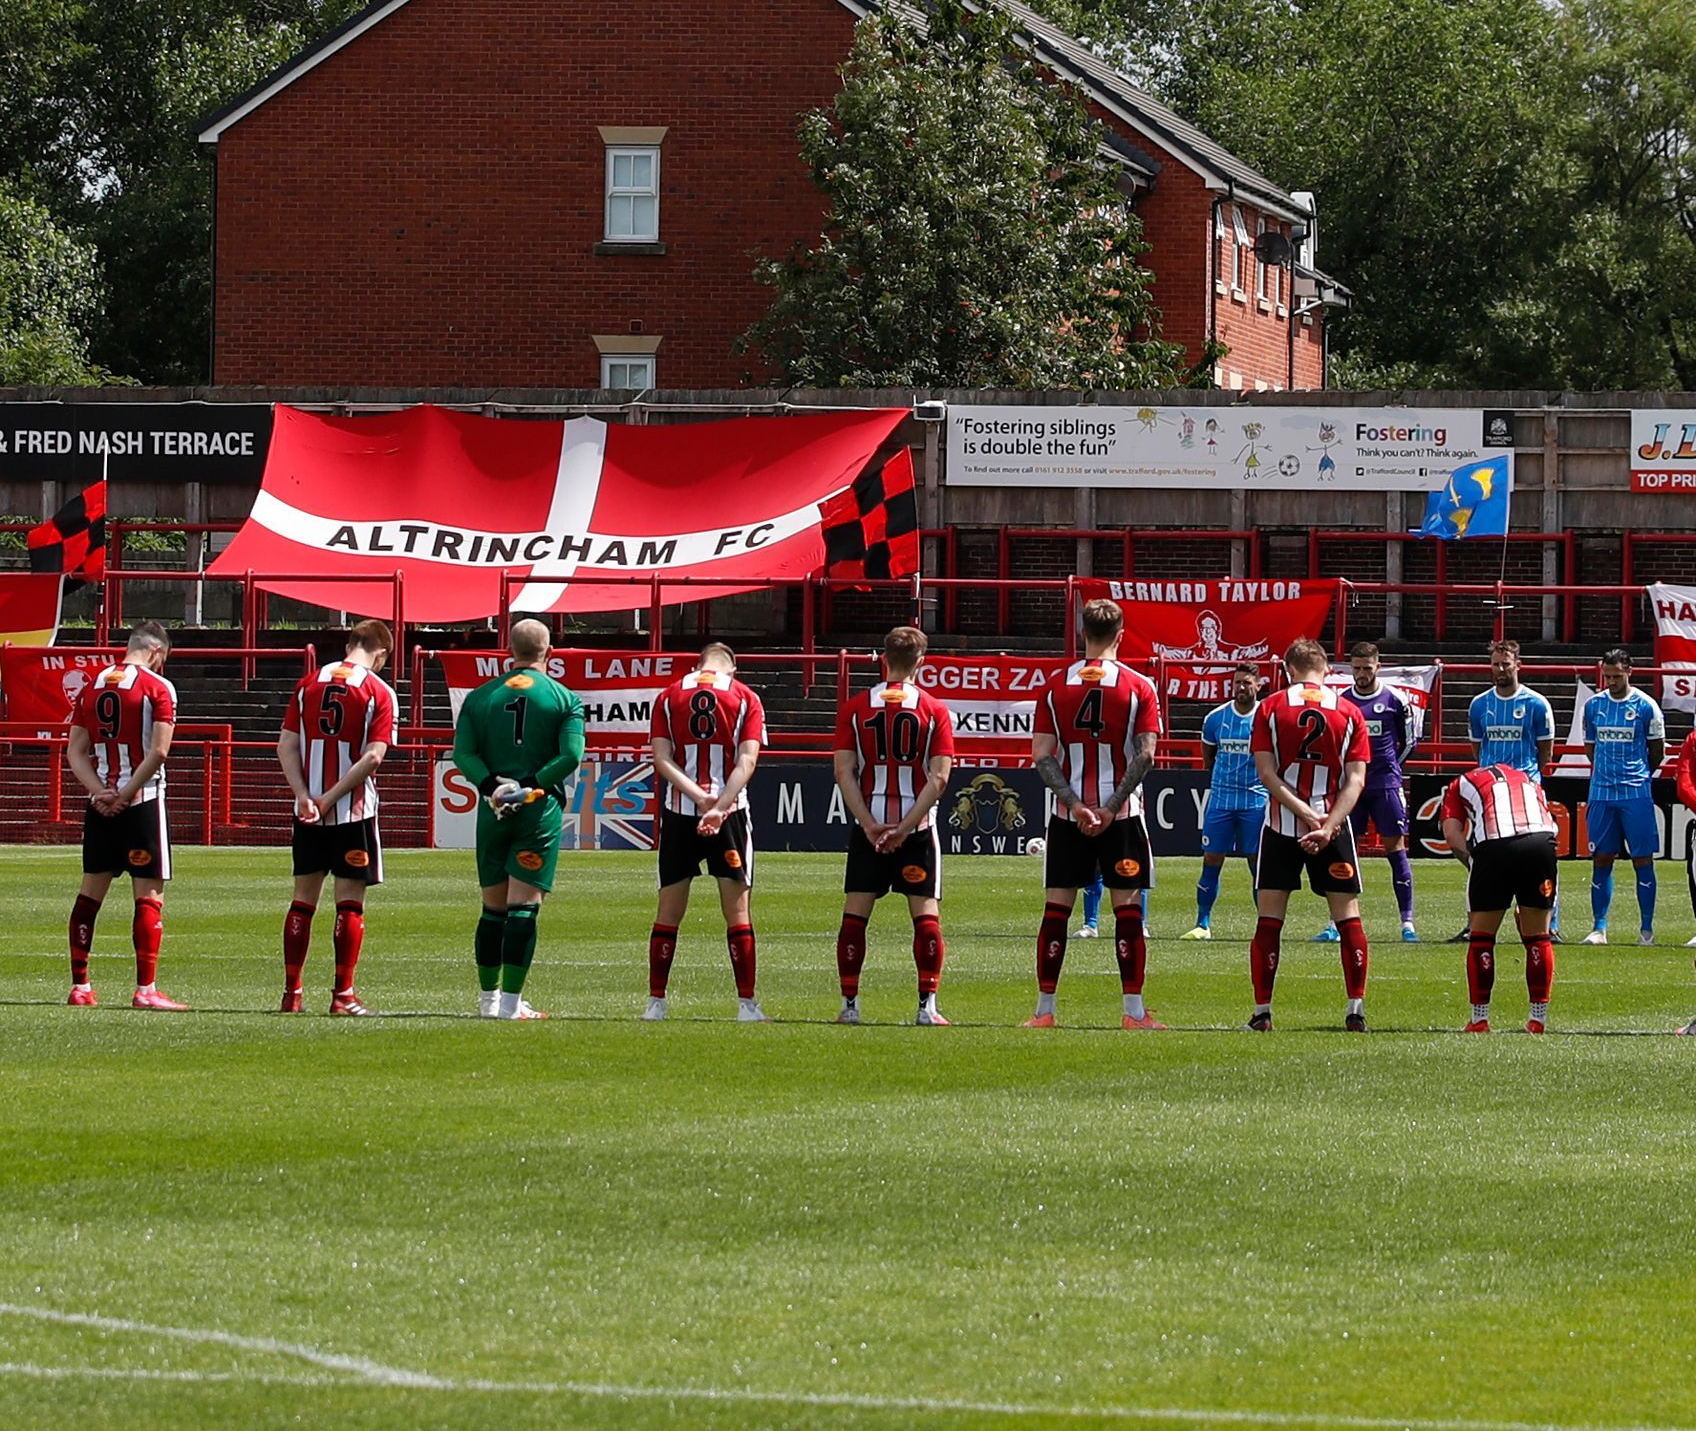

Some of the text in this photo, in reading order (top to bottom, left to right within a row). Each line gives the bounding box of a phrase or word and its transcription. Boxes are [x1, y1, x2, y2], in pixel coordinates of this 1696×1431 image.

[1050, 419, 1116, 438] siblings
[1356, 423, 1447, 446] Fostering
[14, 430, 72, 454] FRED
[79, 431, 143, 455] NASH
[150, 431, 254, 456] TERRACE
[963, 438, 977, 455] is
[981, 439, 1042, 455] double
[1047, 439, 1075, 455] the
[1357, 448, 1381, 457] Think
[1381, 450, 1399, 459] you
[1427, 449, 1450, 458] Think
[1452, 449, 1478, 460] again.
[964, 465, 972, 473] To
[1021, 465, 1034, 474] call
[1638, 474, 1665, 489] TOP
[327, 523, 775, 565] ALTRINCHAM FC
[1109, 581, 1301, 603] BERNARD TAYLOR
[42, 656, 65, 670] IN
[475, 656, 674, 679] MS LANE
[917, 664, 1001, 690] GGER
[1186, 679, 1218, 699] THE
[95, 690, 122, 739] 9
[318, 683, 348, 737] 5
[504, 695, 528, 746] 1
[583, 701, 650, 722] HAM
[688, 689, 718, 740] 8
[1074, 688, 1105, 738] 4
[955, 712, 1031, 732] KENN
[1488, 726, 1521, 740] mbna
[863, 709, 921, 762] 10
[1296, 707, 1327, 761] 2
